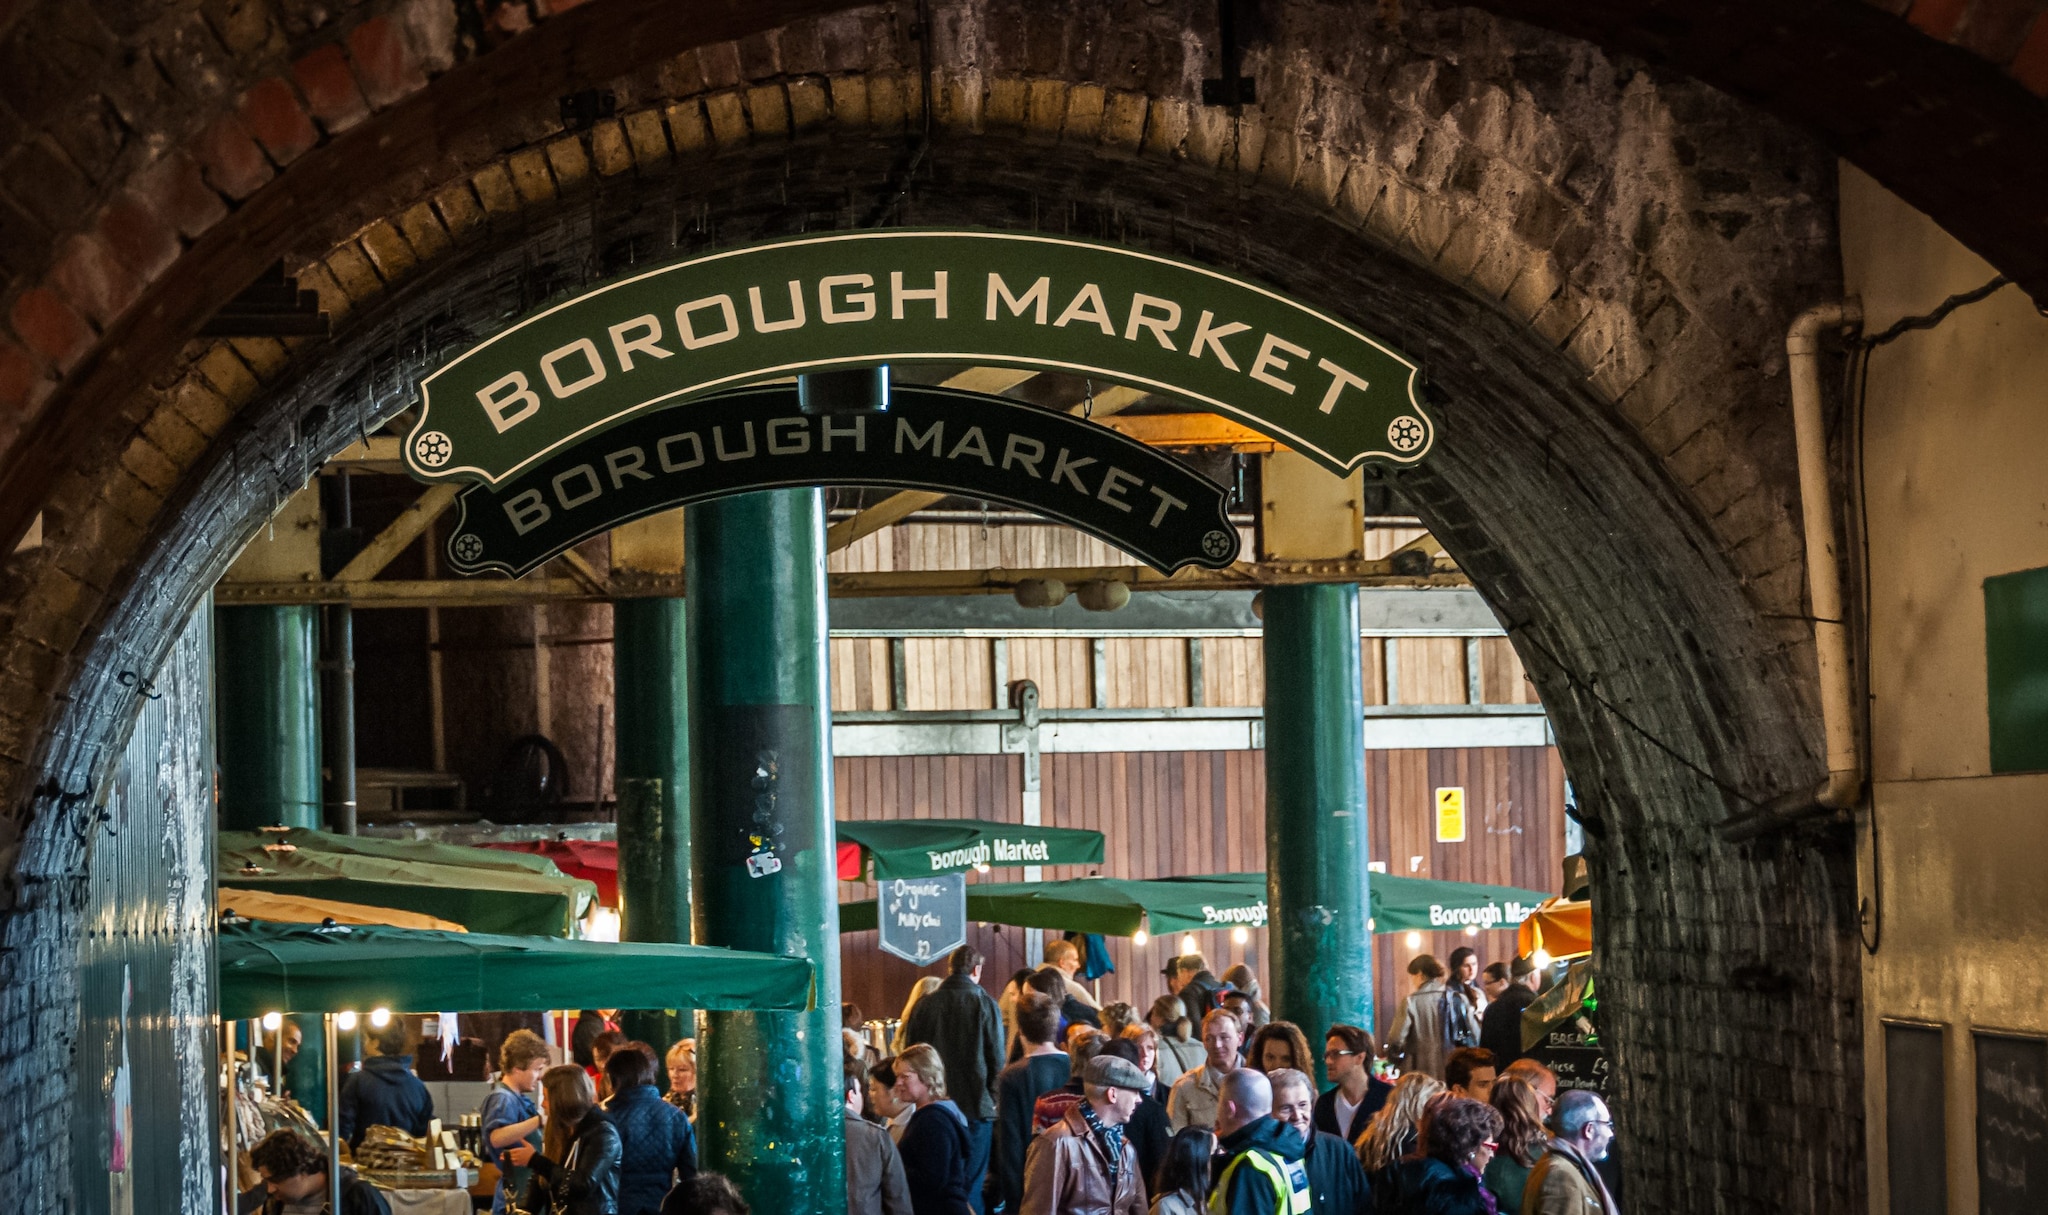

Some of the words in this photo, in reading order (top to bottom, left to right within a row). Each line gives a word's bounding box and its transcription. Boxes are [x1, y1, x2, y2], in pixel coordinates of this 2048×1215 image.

[475, 270, 948, 434] BOROUGH
[985, 272, 1370, 415] MARKET
[502, 415, 866, 536] BOROUGH
[894, 416, 1189, 529] MARKET
[927, 839, 991, 870] Borough
[993, 838, 1050, 862] Market
[1429, 902, 1503, 929] Borough
